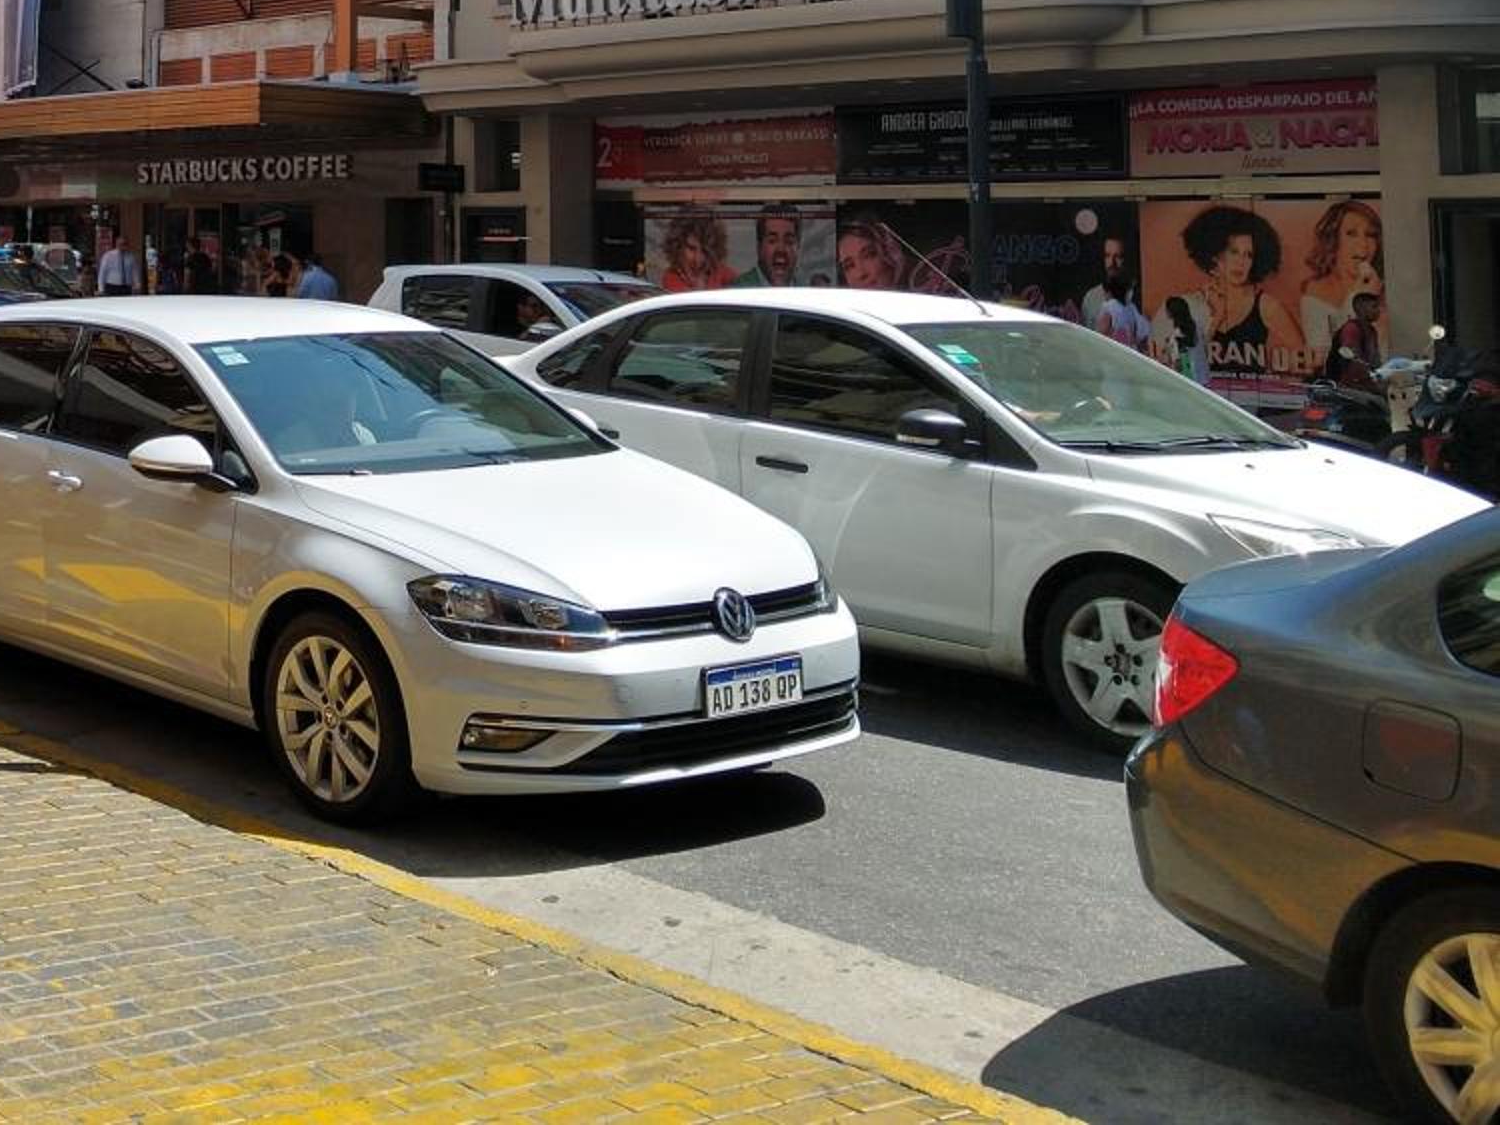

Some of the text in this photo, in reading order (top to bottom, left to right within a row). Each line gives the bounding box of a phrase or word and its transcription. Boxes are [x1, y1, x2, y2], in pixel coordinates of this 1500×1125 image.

[1158, 96, 1224, 114] COMEDIA
[1226, 91, 1323, 109] DESPARPAJO
[1325, 90, 1352, 105] DEL
[881, 112, 925, 132] ANDREA
[928, 109, 969, 131] GHIDO
[1147, 121, 1251, 156] MORIA
[1277, 113, 1380, 151] NACH
[137, 154, 350, 184] STARBUCKS COFFEE
[1206, 340, 1266, 367] RAN
[713, 673, 798, 714] AD 138 QP
